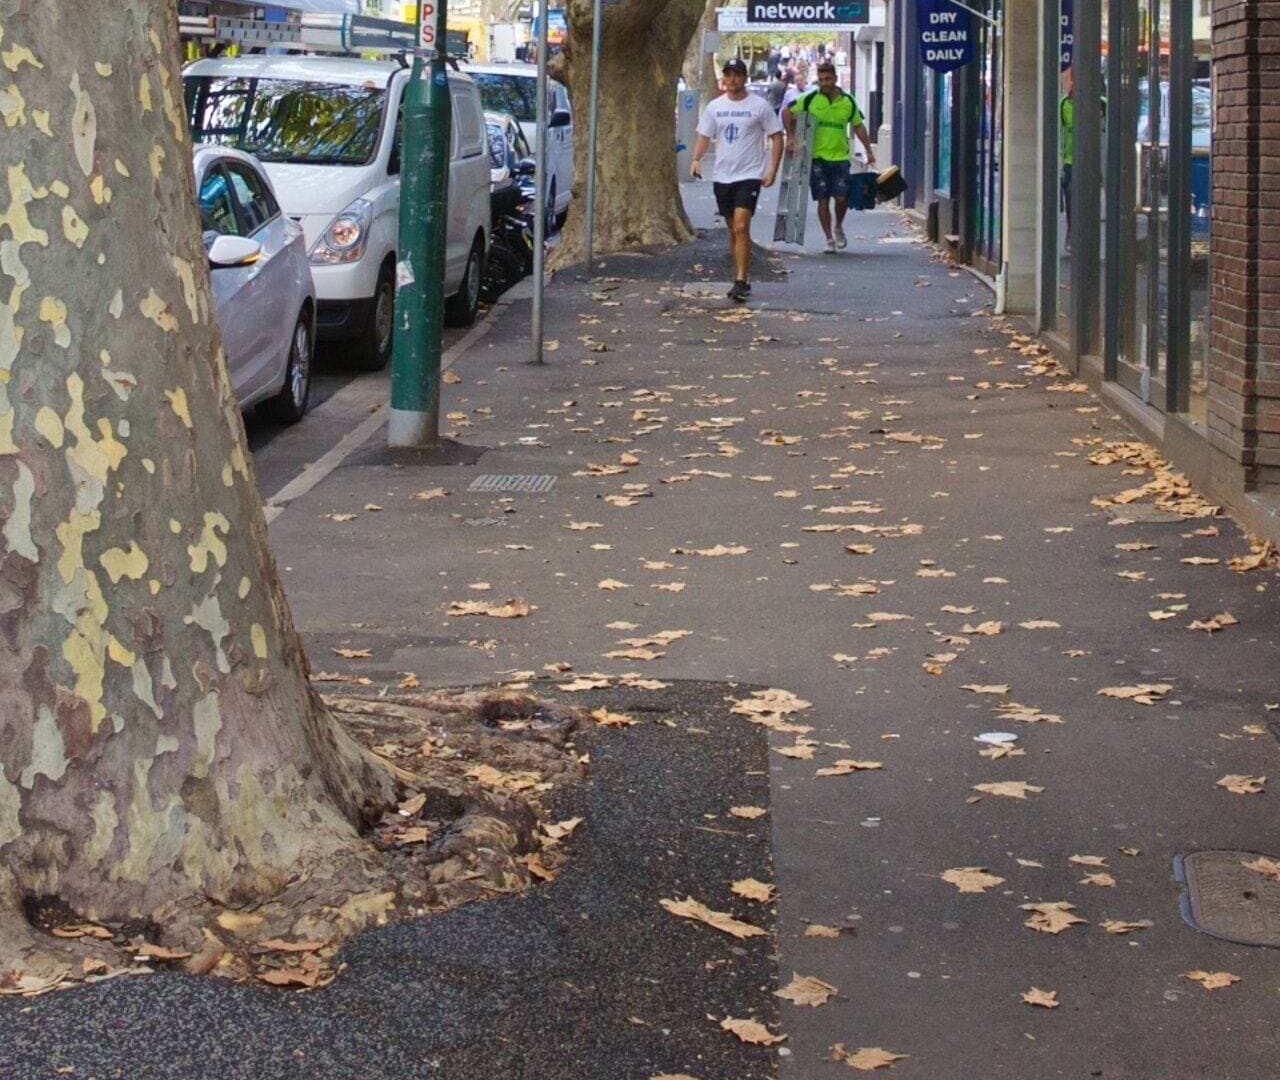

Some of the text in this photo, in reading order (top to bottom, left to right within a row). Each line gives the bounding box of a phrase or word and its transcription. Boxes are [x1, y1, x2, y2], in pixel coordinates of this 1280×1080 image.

[754, 1, 836, 20] network
[929, 12, 957, 24] DRY
[922, 30, 967, 43] CLEAN
[926, 49, 964, 61] DAILY
